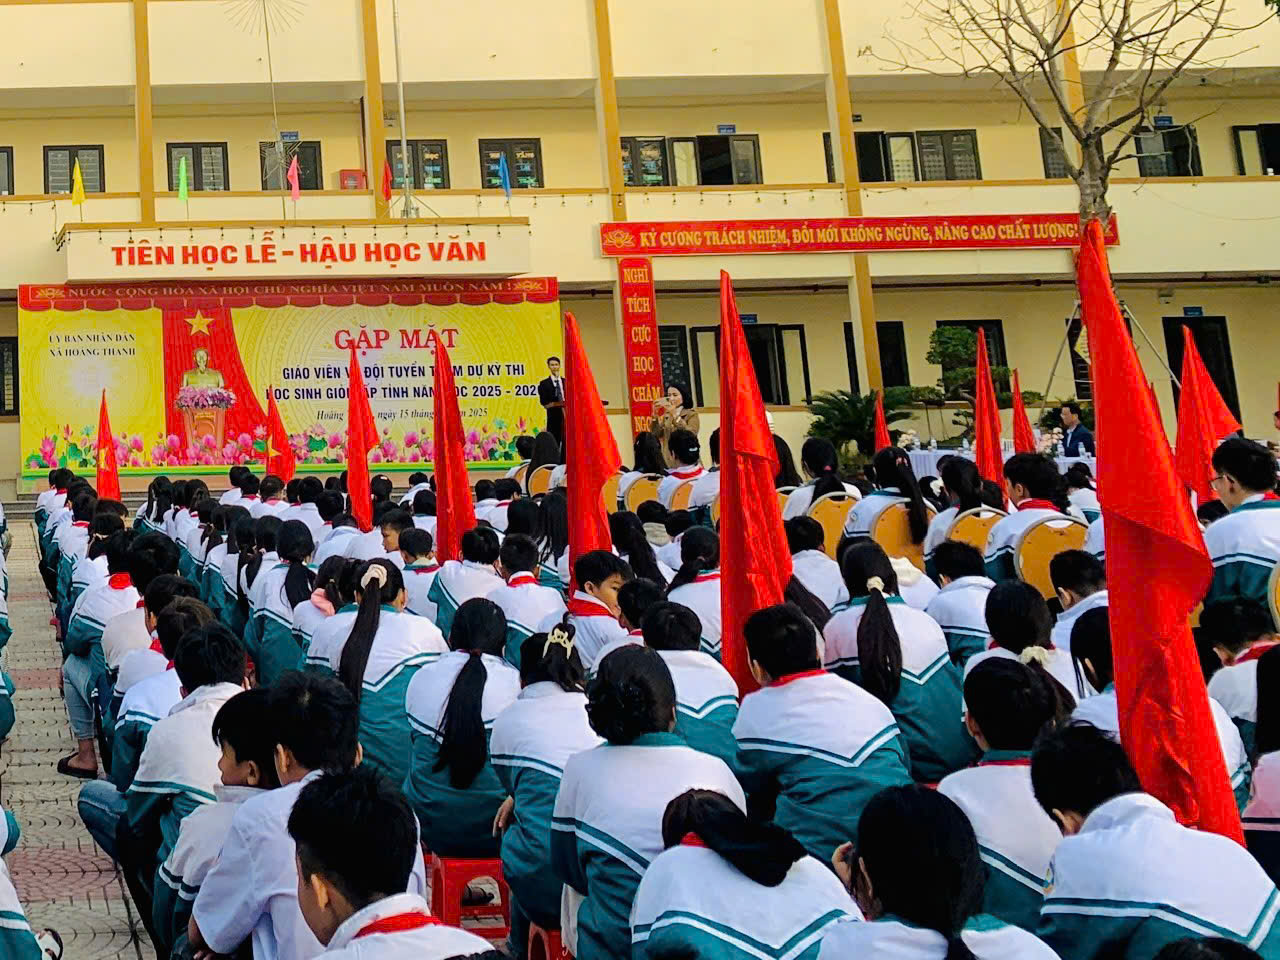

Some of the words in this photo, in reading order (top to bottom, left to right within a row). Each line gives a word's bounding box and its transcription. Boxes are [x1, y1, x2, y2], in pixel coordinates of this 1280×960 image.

[660, 230, 702, 246] CƯƠNG
[704, 226, 745, 245] TRÁCH
[748, 225, 790, 248] NHIỆM,
[792, 221, 814, 244] ĐỔI
[816, 224, 838, 243] MỚI
[841, 224, 883, 242] KHÔNG
[885, 222, 933, 244] NGỪNG,
[934, 221, 968, 240] NÂNG
[971, 224, 996, 240] CAO
[998, 218, 1031, 239] CHẤT
[1033, 223, 1079, 242] LƯỢNG!
[111, 238, 174, 266] TIÊN
[181, 244, 238, 271] HỌC
[245, 230, 277, 264] LỄ
[299, 236, 357, 269] HẬU
[364, 243, 421, 268] HỌC
[428, 235, 486, 262] VĂN
[115, 286, 158, 298] CỘNG
[223, 284, 249, 296] HỘI
[342, 282, 377, 294] VIỆT
[381, 283, 414, 293] NAM
[420, 281, 465, 292] MUÔN
[469, 281, 503, 291] NĂM
[626, 292, 651, 312] TÍCH
[64, 334, 83, 343] BAN
[334, 324, 390, 356] GẶP
[399, 324, 459, 356] MẶT
[631, 324, 652, 346] CỰC
[282, 365, 310, 379] GIÁO
[314, 363, 341, 379] VIÊN
[363, 363, 384, 380] ĐỘI
[388, 360, 426, 378] TUYỂN
[429, 365, 463, 377] TM
[468, 364, 483, 379] DỰ
[505, 364, 525, 376] THI
[632, 356, 654, 375] HỌC
[294, 387, 322, 400] SINH
[473, 385, 502, 397] 2025
[515, 385, 539, 396] 202
[399, 409, 409, 419] 15
[469, 408, 488, 417] 2025
[634, 415, 654, 433] NGO
